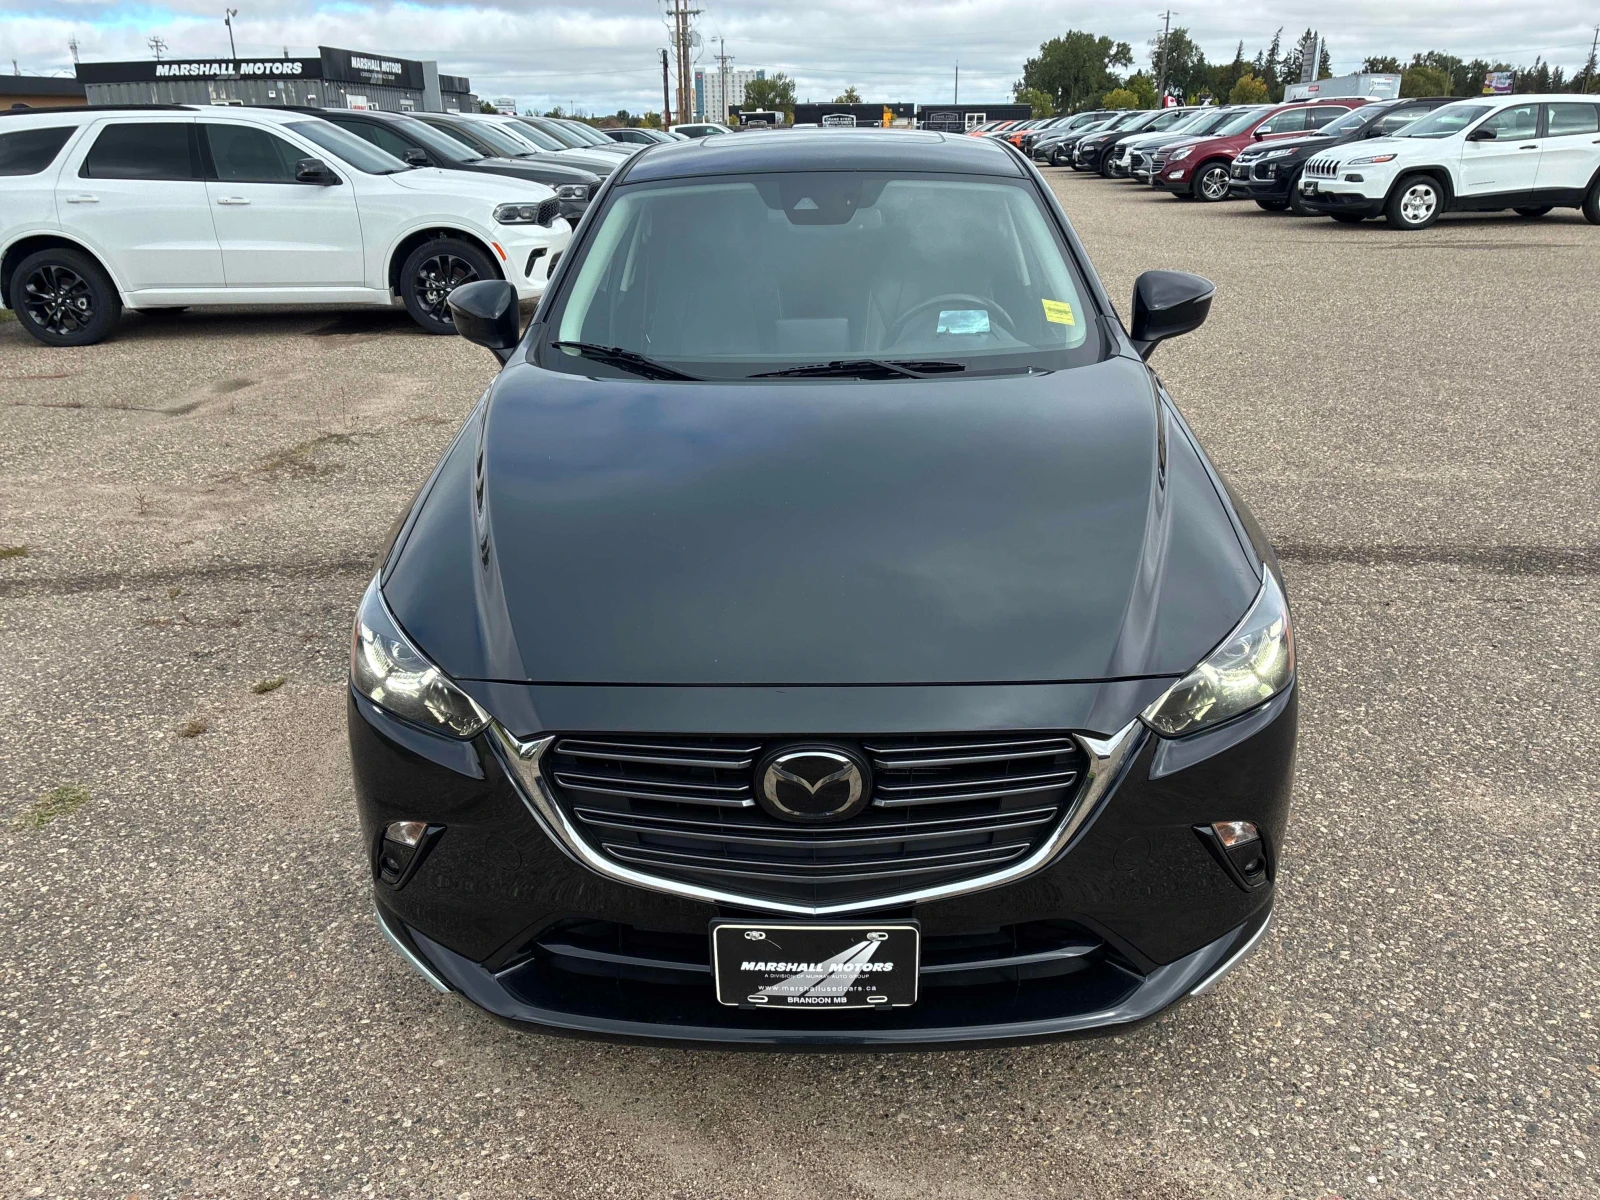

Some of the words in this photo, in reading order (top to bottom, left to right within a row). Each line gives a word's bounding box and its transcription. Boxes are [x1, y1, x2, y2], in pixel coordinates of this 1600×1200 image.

[155, 63, 236, 76] MARSHALL
[240, 62, 303, 75] MOTORS
[351, 56, 381, 71] MARSHALL
[381, 60, 402, 74] MOTORS
[740, 962, 824, 972] MARSHALL
[829, 962, 894, 972] MOTORS
[757, 984, 877, 992] www.marshallusedcars.ca
[833, 996, 848, 1004] MB
